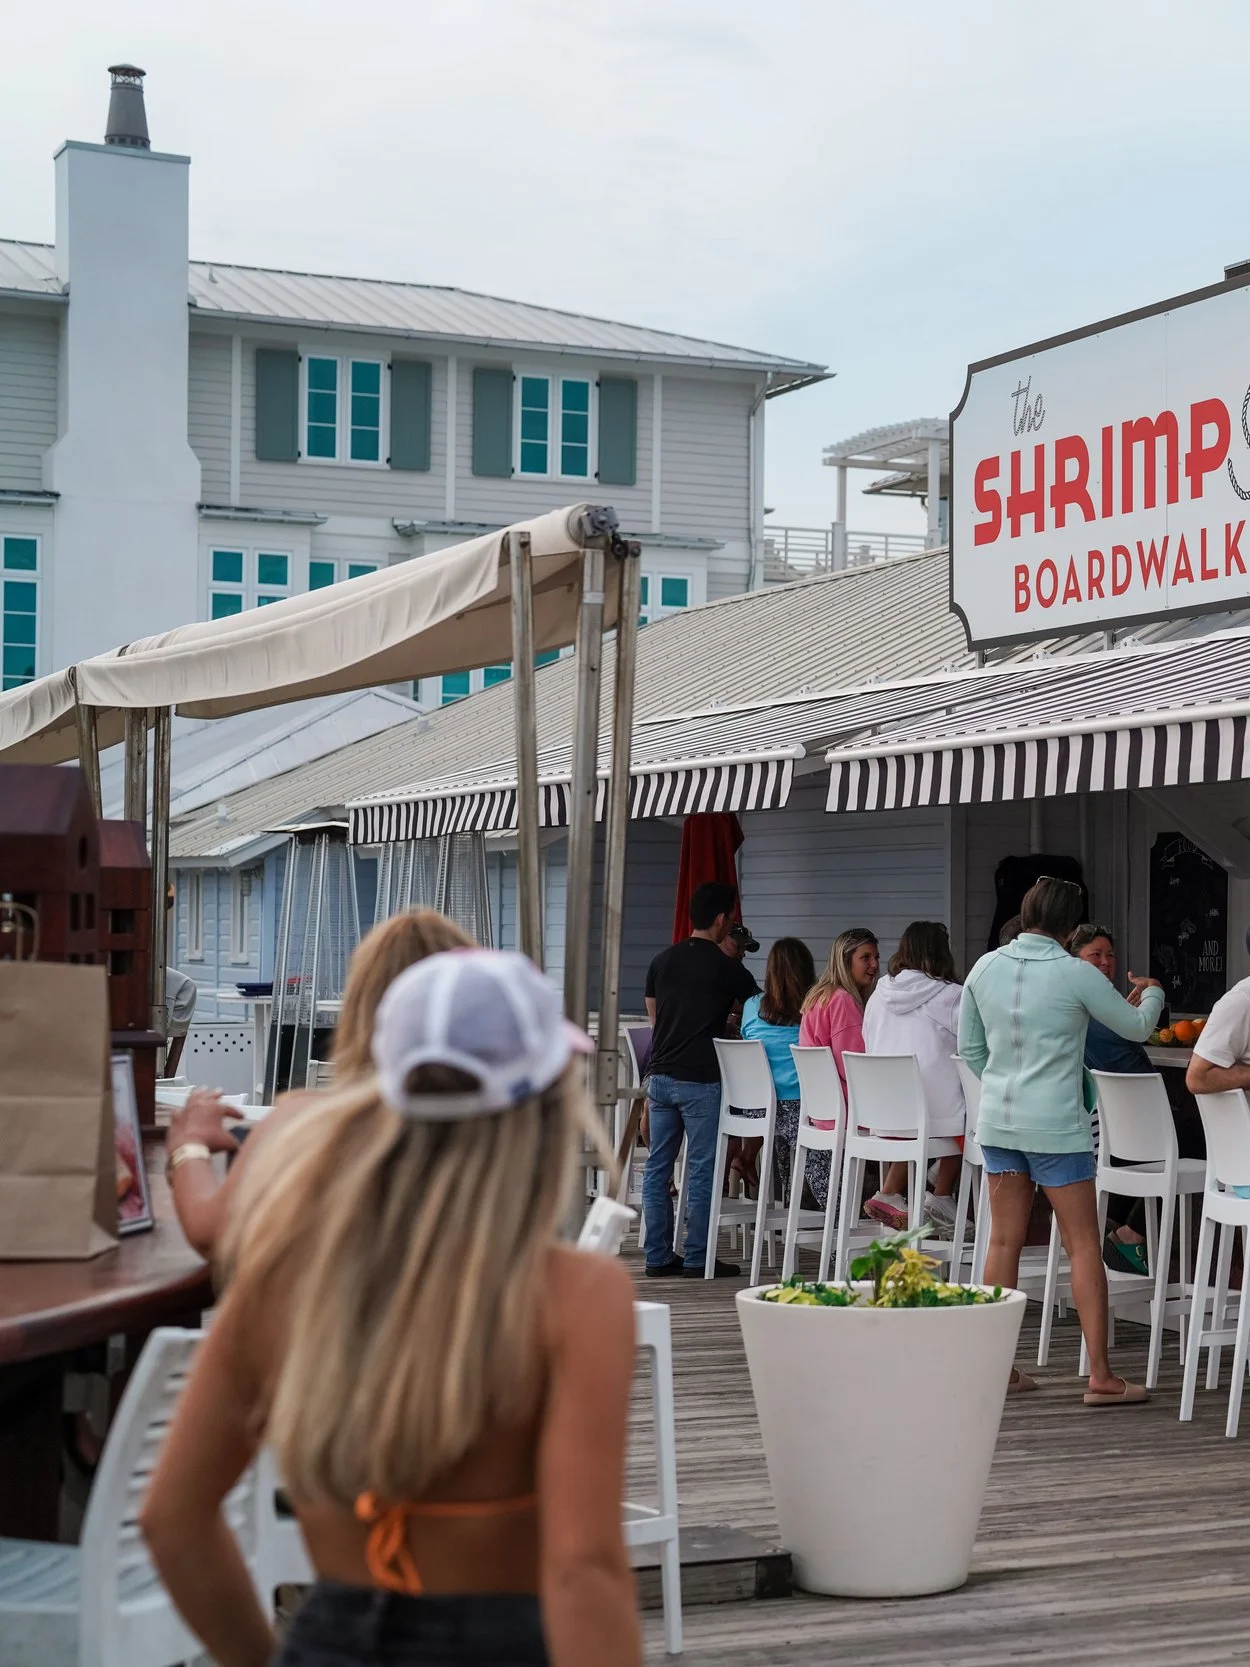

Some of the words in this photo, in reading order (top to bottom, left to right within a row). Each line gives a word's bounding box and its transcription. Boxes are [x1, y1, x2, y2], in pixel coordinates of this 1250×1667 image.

[1011, 375, 1046, 437] the
[974, 398, 1231, 547] SHRIMP
[1014, 520, 1247, 613] BOARDWALK
[1203, 941, 1218, 956] AND
